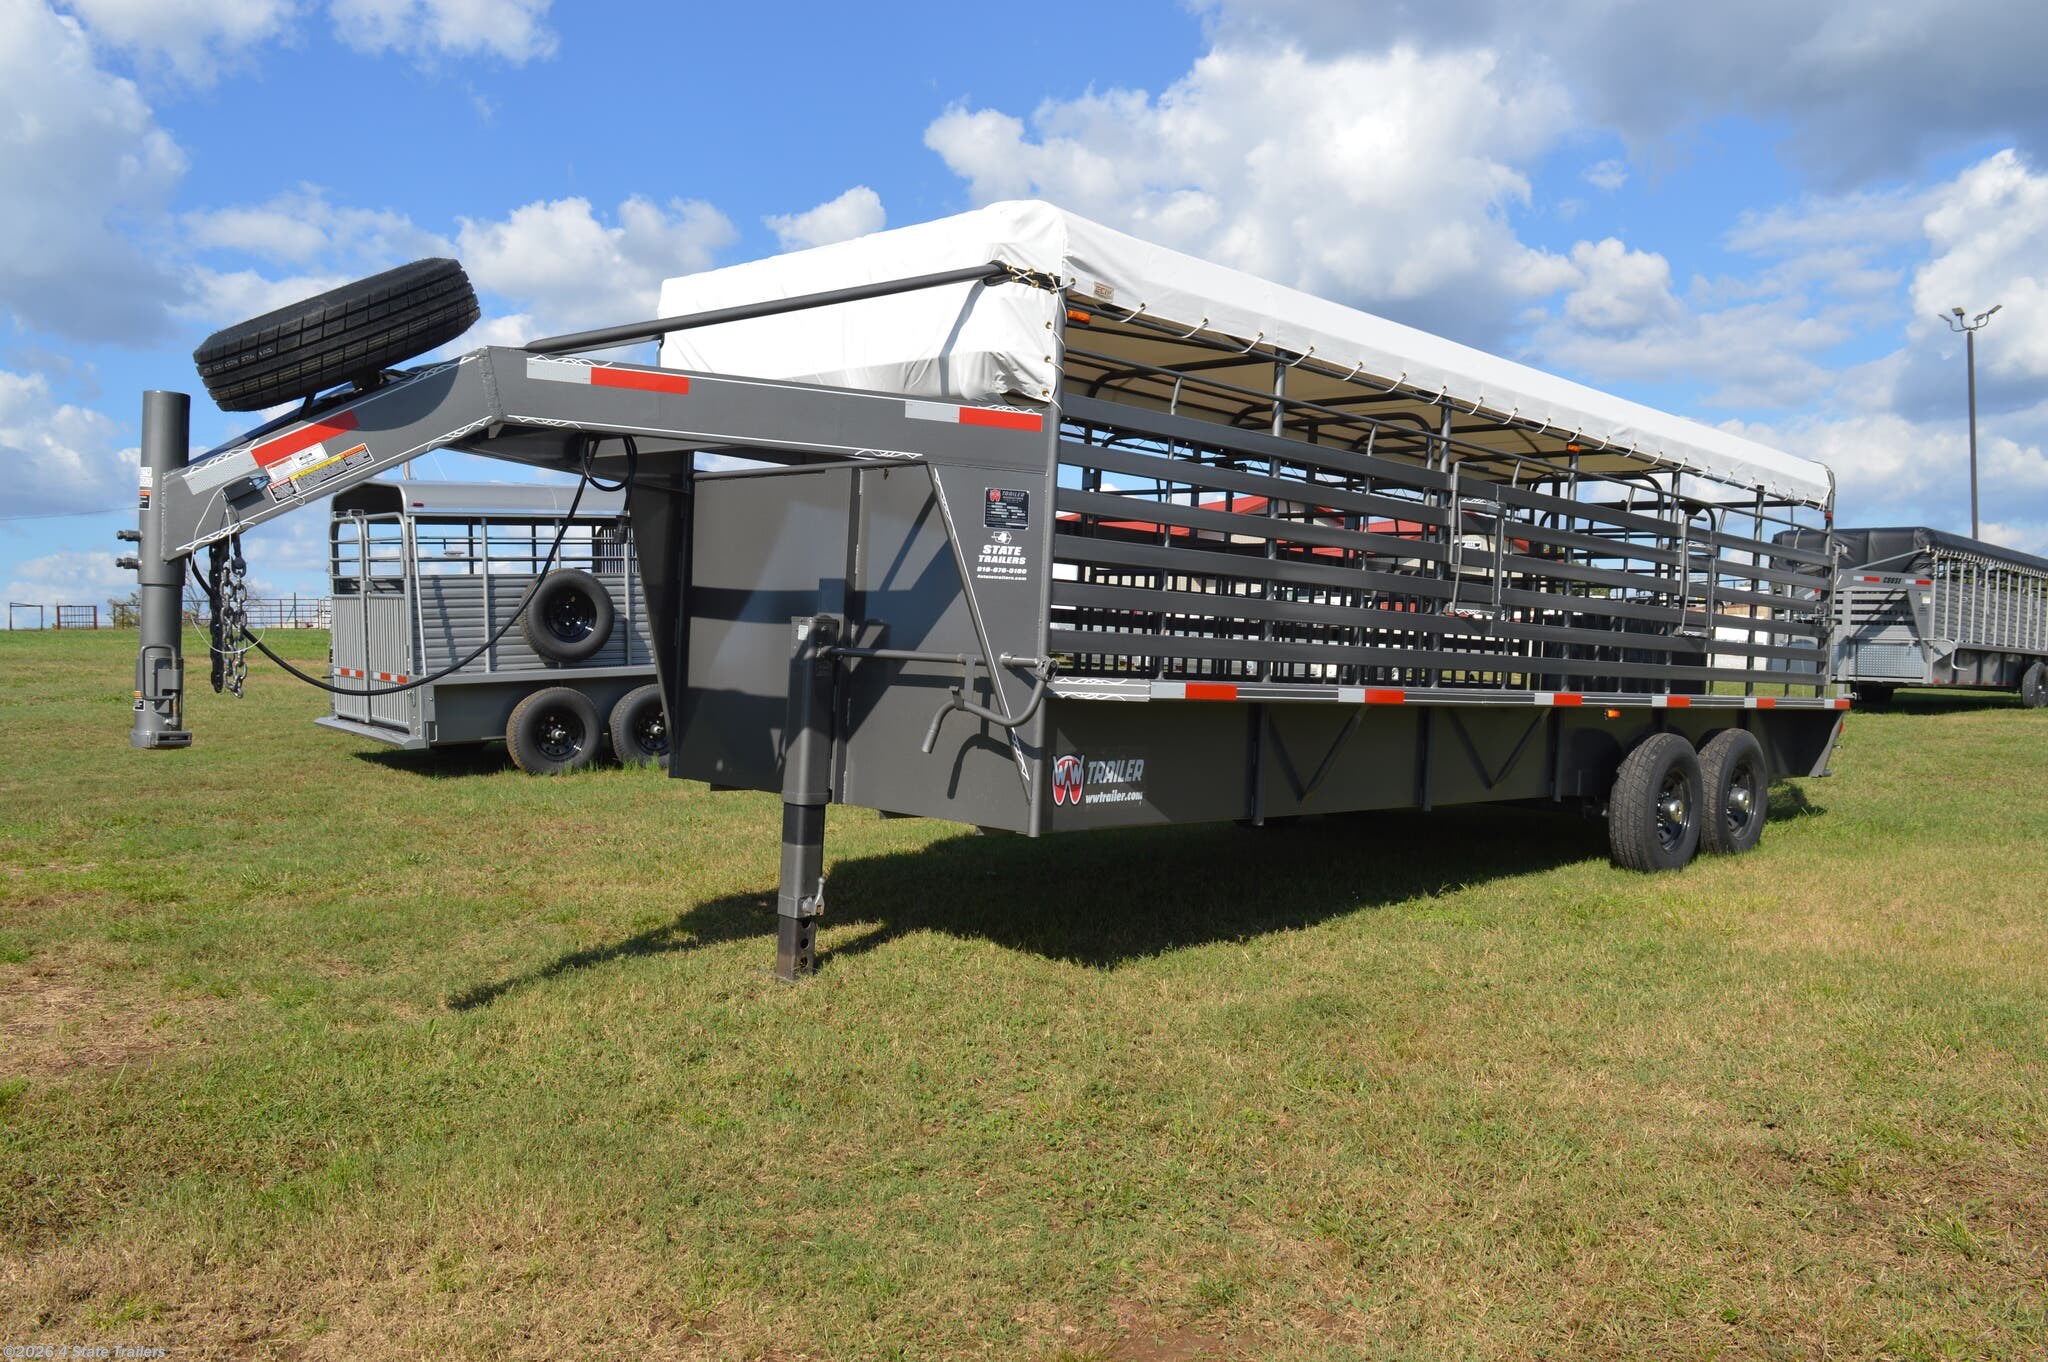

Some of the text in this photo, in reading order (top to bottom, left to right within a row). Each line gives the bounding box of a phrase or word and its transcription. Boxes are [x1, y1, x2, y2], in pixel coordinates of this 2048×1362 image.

[982, 544, 1022, 556] STATE
[978, 555, 1027, 565] TRAILERS
[1087, 759, 1145, 784] TRAILER
